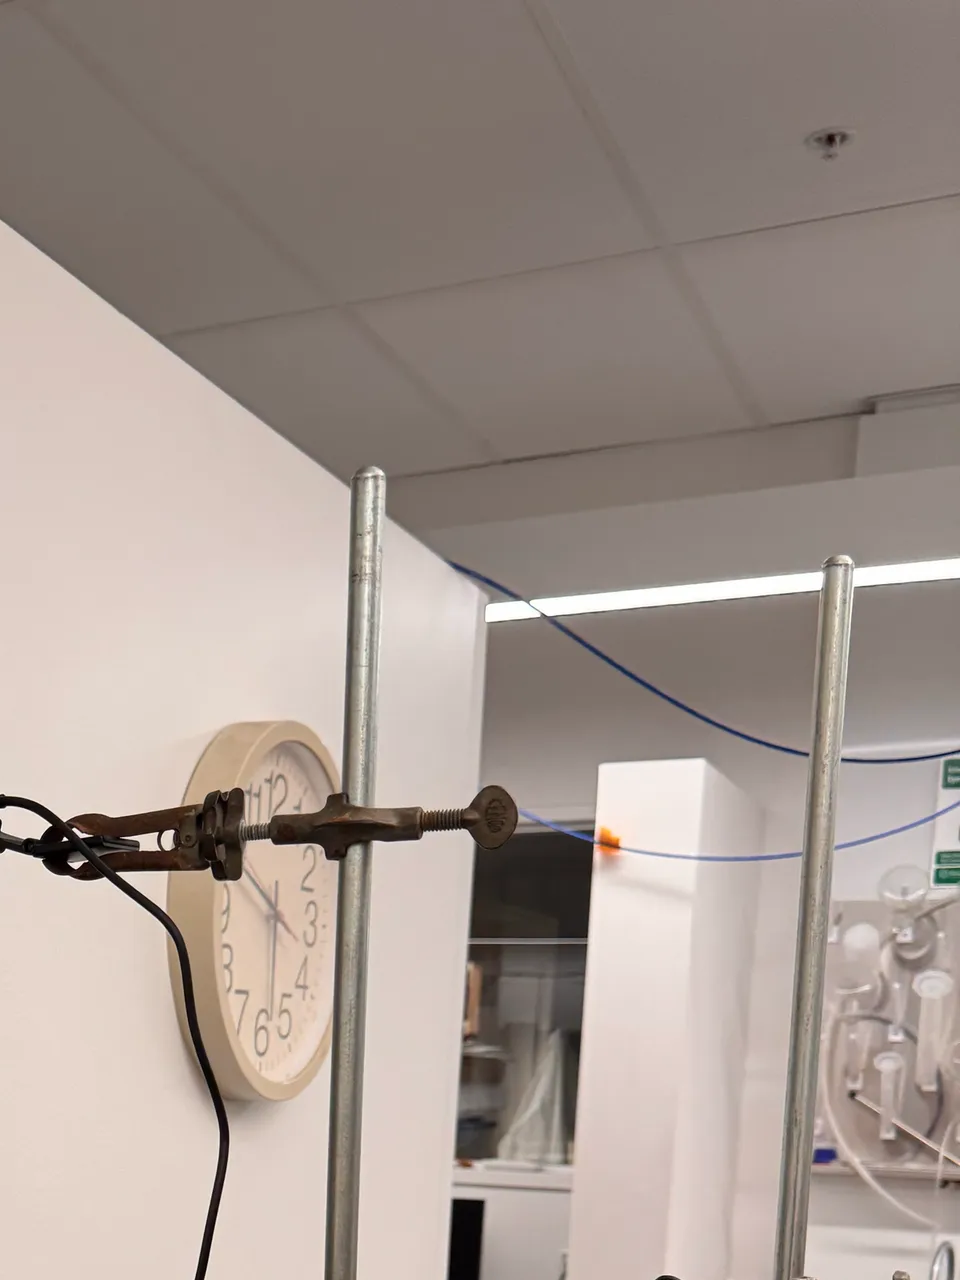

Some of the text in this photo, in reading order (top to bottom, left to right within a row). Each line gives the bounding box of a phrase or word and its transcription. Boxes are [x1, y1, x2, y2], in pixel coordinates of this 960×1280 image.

[301, 845, 316, 893] 2
[302, 900, 318, 949] 3
[295, 954, 309, 1001] 4
[234, 989, 249, 1037] 7
[253, 1007, 271, 1058] 6
[277, 993, 293, 1040] 5
